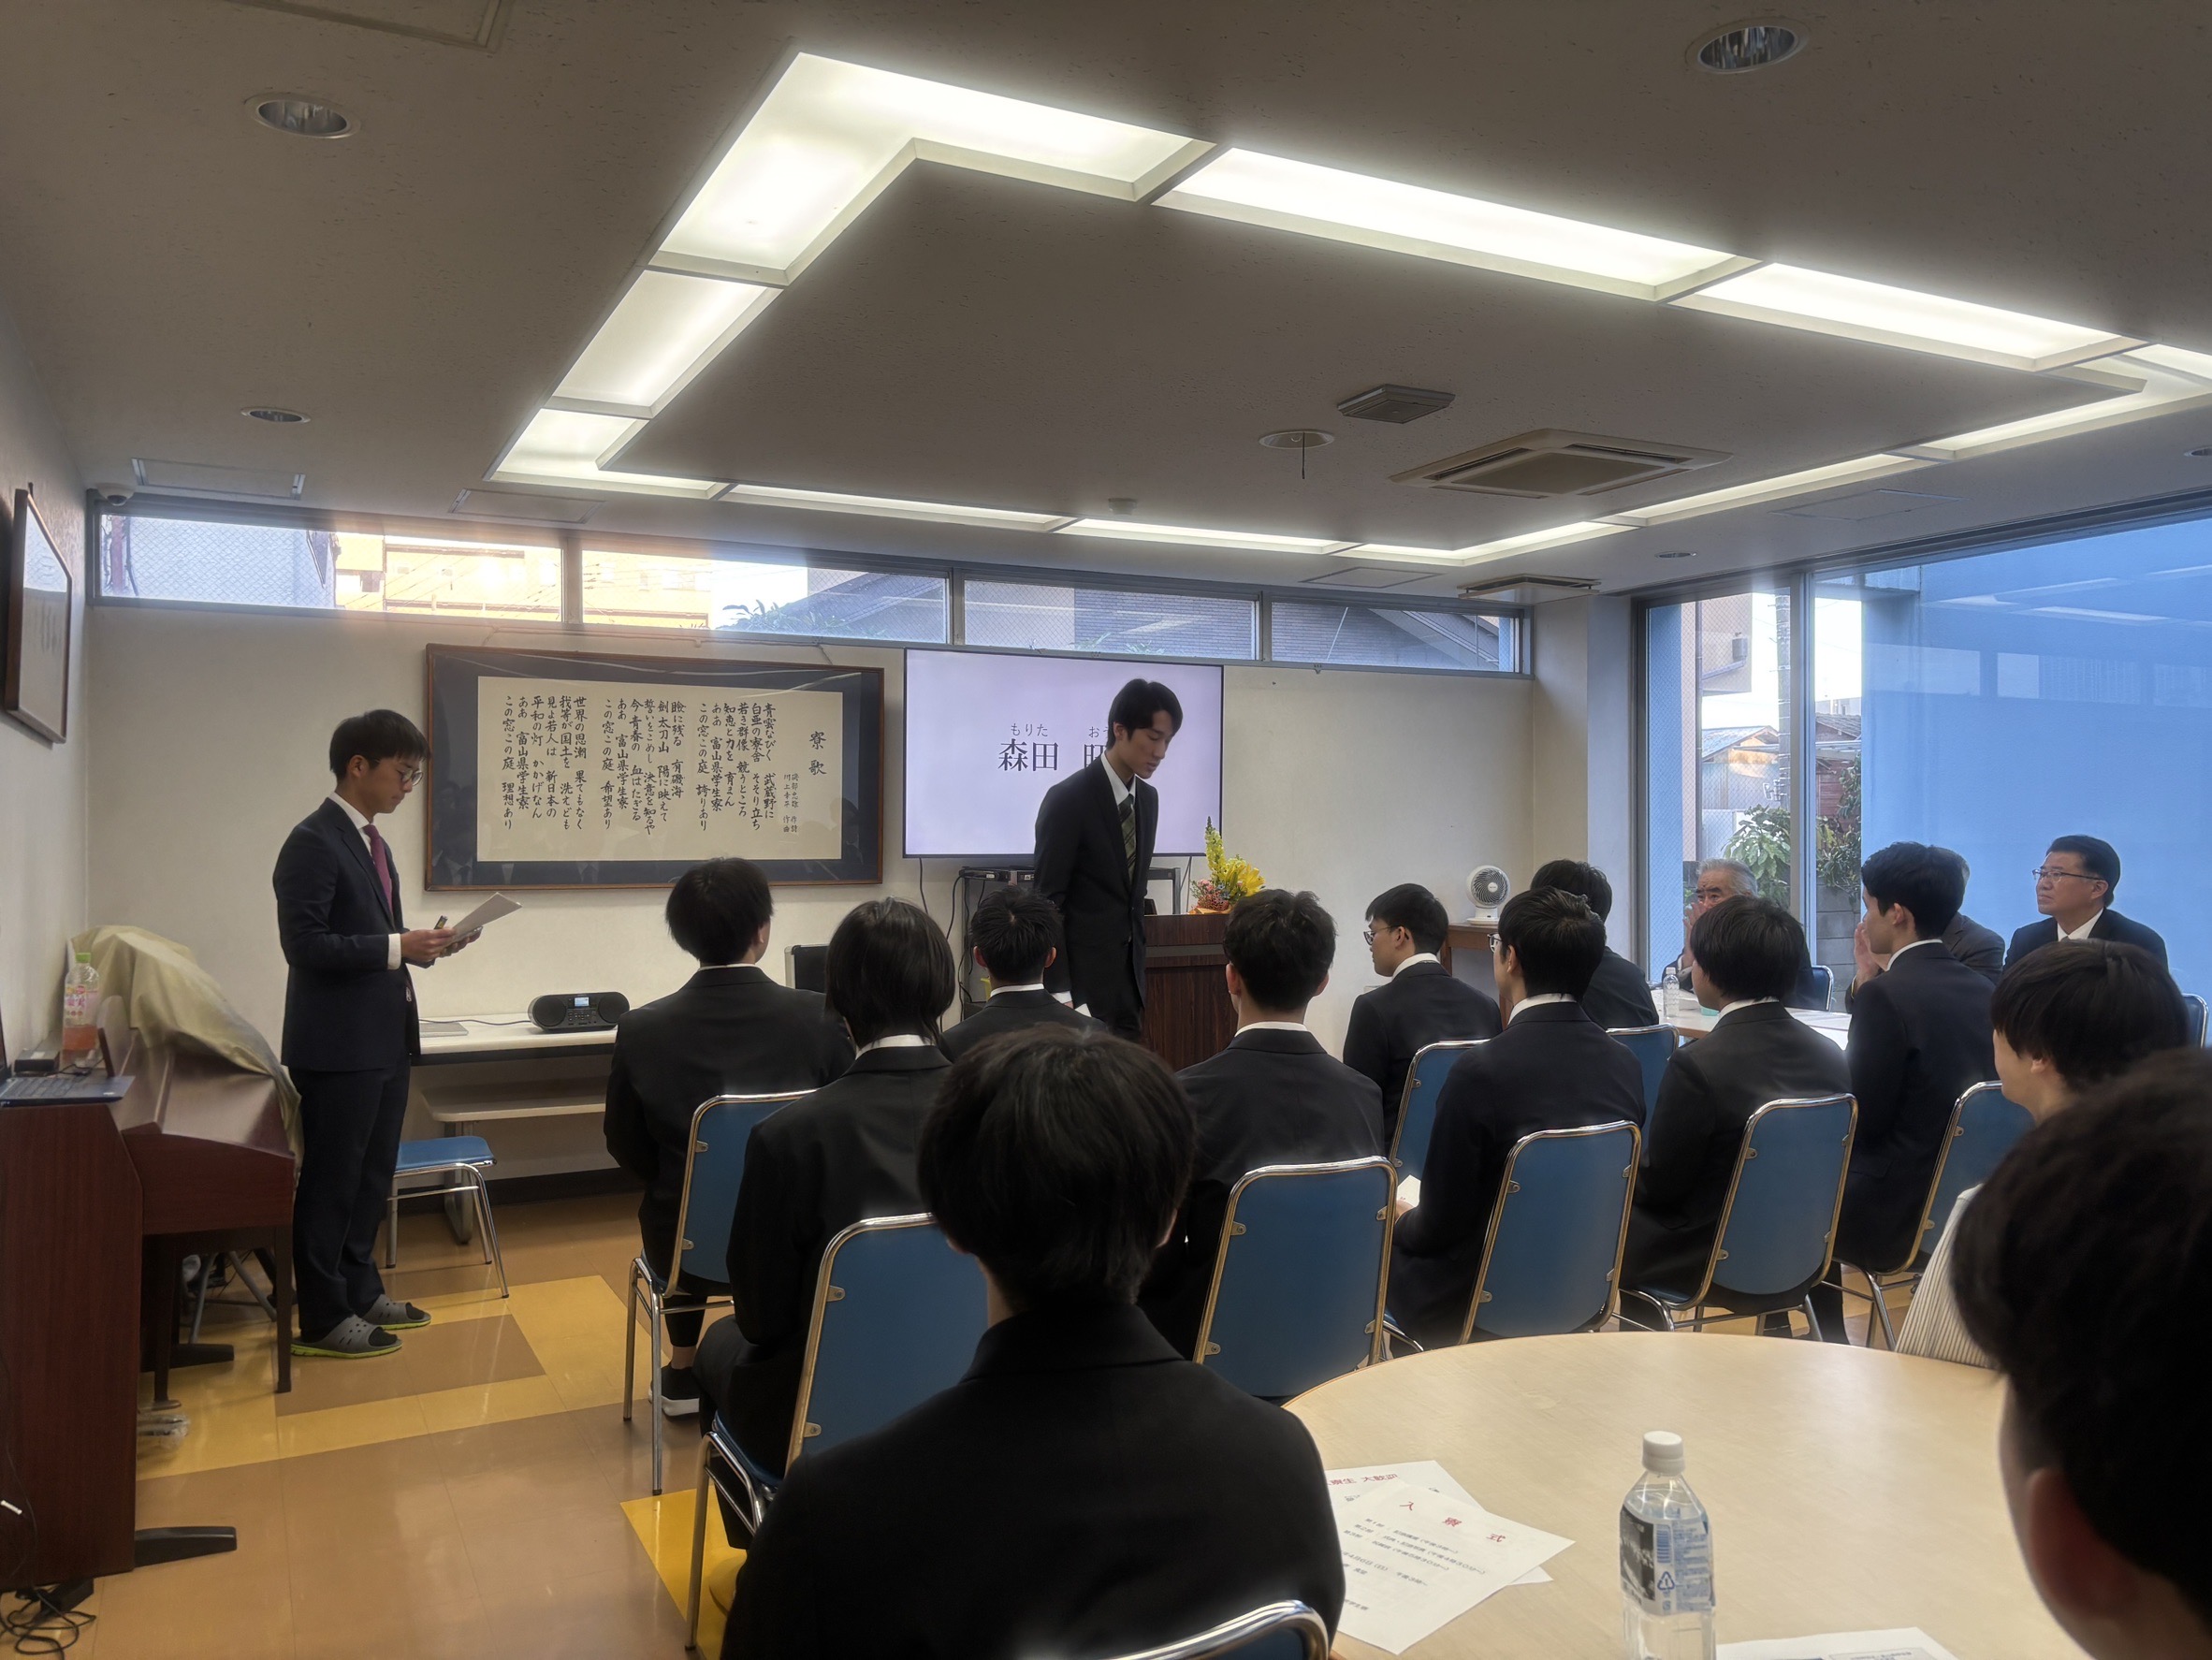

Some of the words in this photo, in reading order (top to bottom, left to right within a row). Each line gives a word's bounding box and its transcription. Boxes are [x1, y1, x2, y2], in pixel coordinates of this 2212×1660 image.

[502, 695, 516, 770] この窓この庭
[517, 696, 529, 719] ああ
[530, 695, 545, 747] 平和の灯
[545, 695, 559, 757] 見よ若人は
[560, 695, 574, 768] 我等が国土を
[574, 696, 588, 759] 世界の思潮
[602, 699, 615, 772] この窓この庭
[618, 697, 627, 721] ああ
[629, 698, 644, 751] 今青春の
[644, 698, 656, 764] 誓いをこめし
[711, 702, 722, 727] ああ
[723, 703, 736, 762] 知恵と力を
[736, 702, 749, 751] 若き群像
[763, 702, 777, 762] 青雲なびく
[1011, 722, 1048, 737] もりた
[697, 703, 710, 775] この窓この庭
[808, 731, 827, 776] 寮歌
[997, 738, 1058, 772] 森田
[516, 731, 531, 809] 富山県学生寮
[531, 759, 545, 819] かかげなん
[545, 770, 560, 818] 新日本の
[615, 733, 629, 809] 富山県学生寮
[630, 764, 644, 822] 血はたぎる
[657, 764, 672, 822] 陽に映えて
[670, 759, 686, 799] 有磯海
[710, 736, 723, 812] 富山県学生寮
[724, 771, 736, 807] 育まん
[736, 761, 750, 817] 競うところ
[764, 773, 777, 819] 武蔵野に
[502, 781, 515, 830] 理想あり
[560, 781, 574, 830] 洗えども
[575, 769, 588, 830] 果てもなく
[600, 780, 615, 830] 希望あり
[643, 771, 657, 836] 決意を知るや
[695, 783, 711, 831] 誇りあり
[750, 773, 764, 831] そそり立ち
